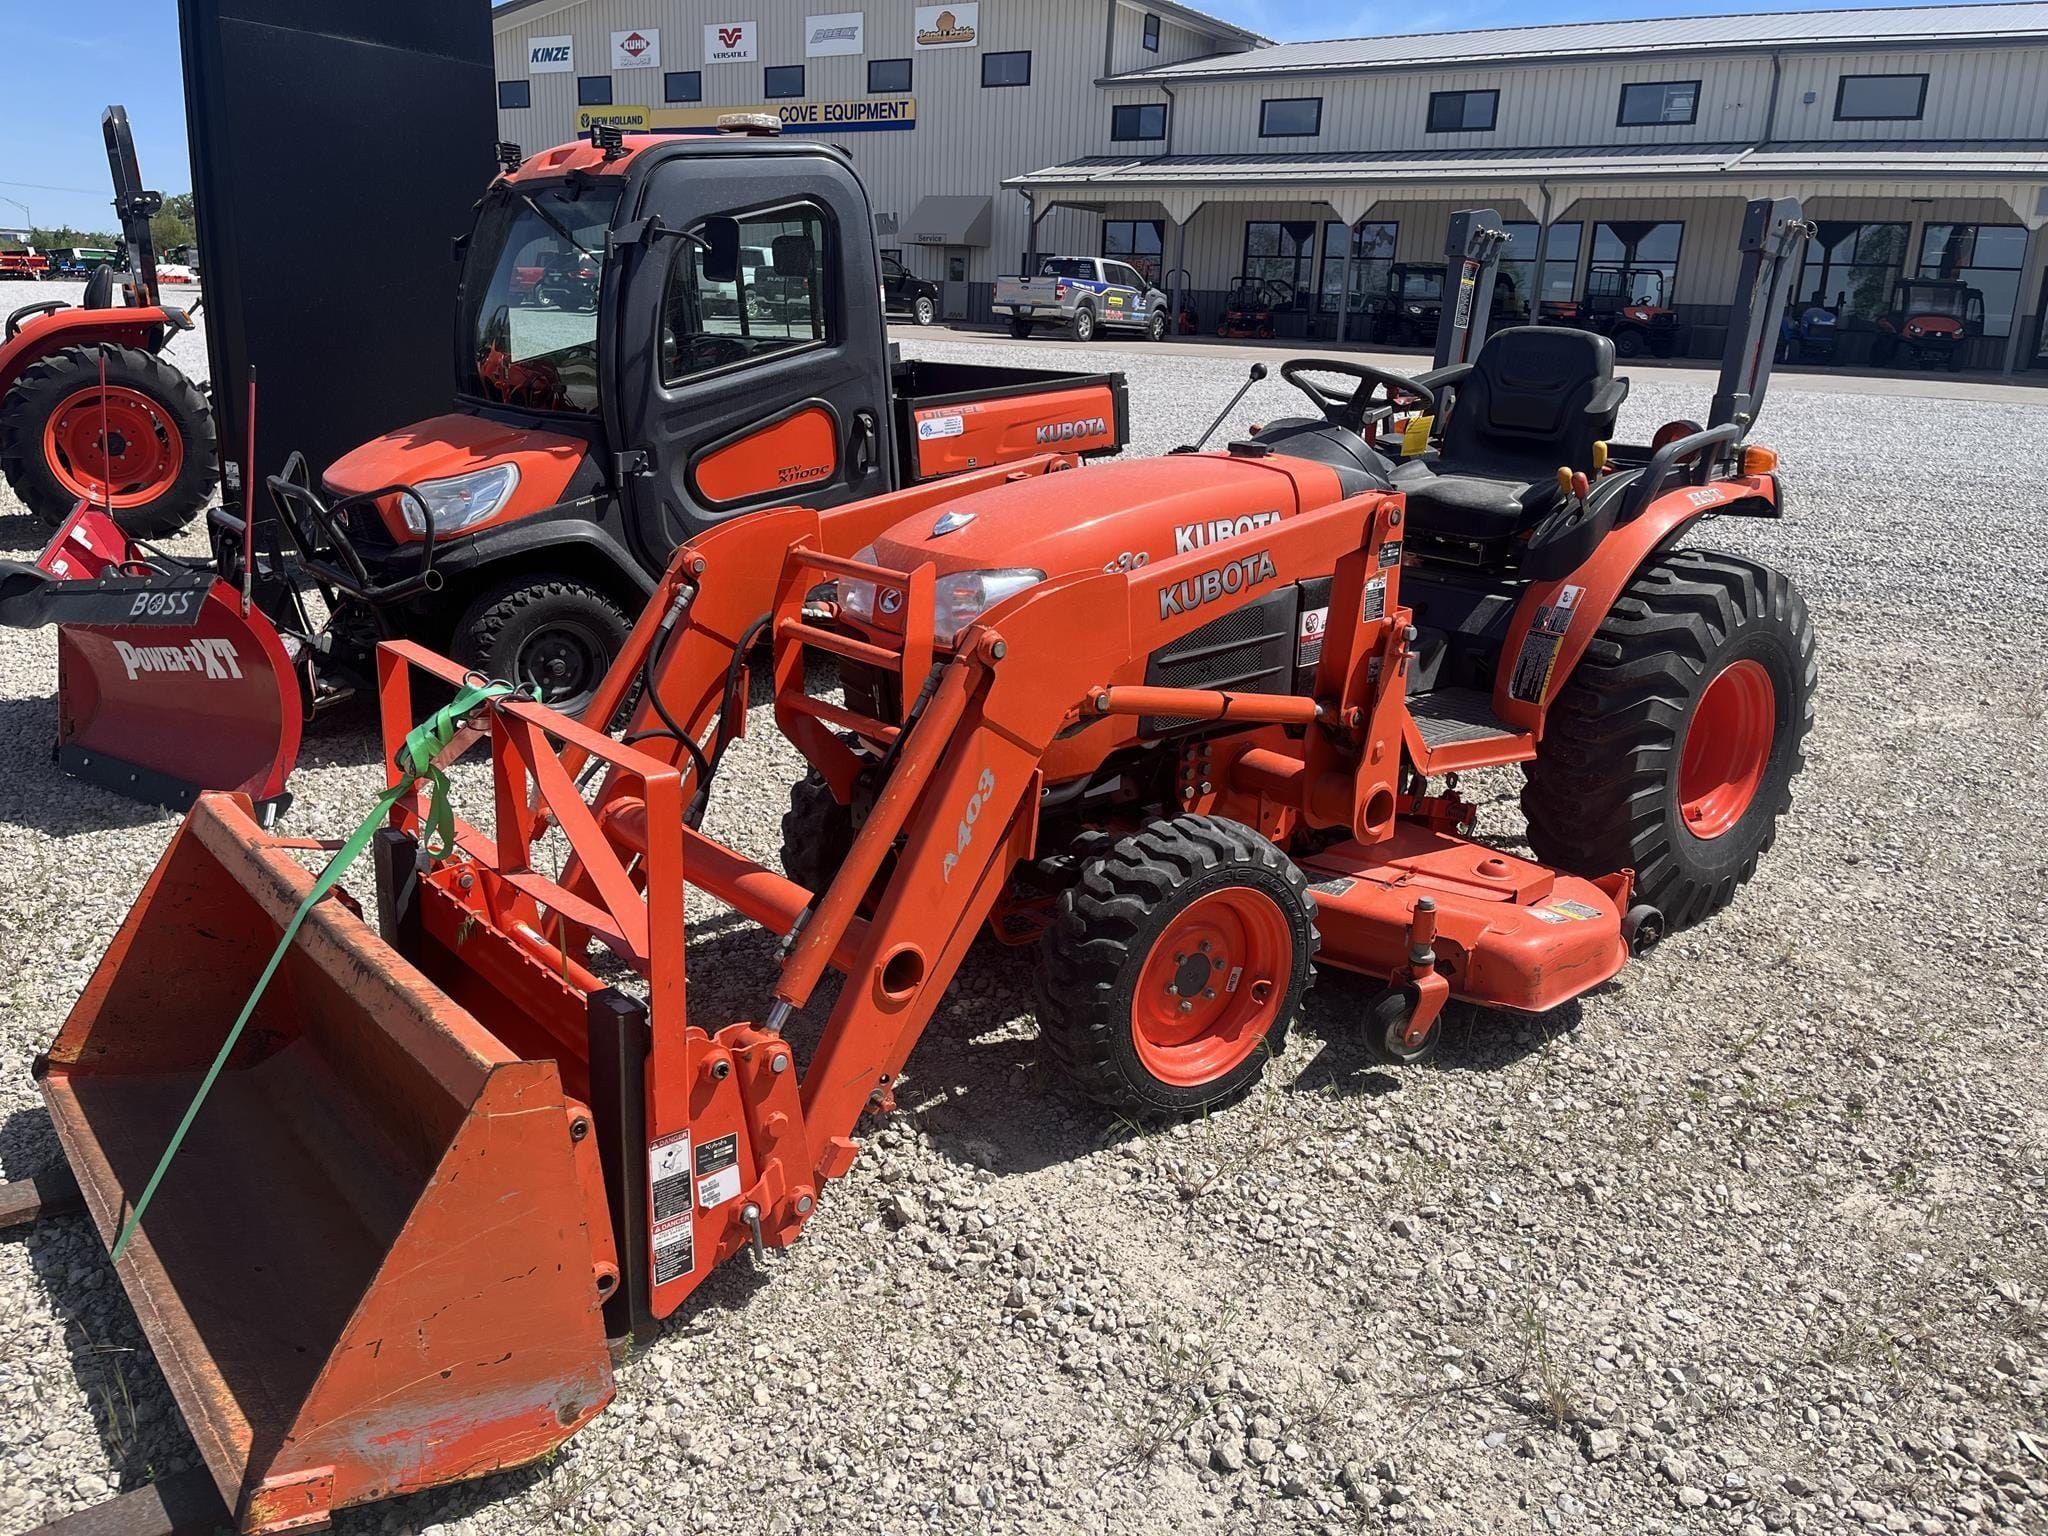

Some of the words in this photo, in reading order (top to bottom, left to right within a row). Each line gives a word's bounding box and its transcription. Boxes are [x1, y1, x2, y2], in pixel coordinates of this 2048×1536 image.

[623, 39, 647, 50] KUHN
[531, 46, 570, 63] KINZE
[713, 51, 748, 59] VERSATILE
[591, 116, 608, 125] NEW
[609, 115, 643, 125] HOLLAND
[779, 104, 819, 123] COVE
[823, 101, 908, 121] EQUIPMENT
[918, 233, 943, 243] Service
[922, 405, 982, 420] DIESEL
[1035, 416, 1108, 444] KUBOTA
[777, 464, 830, 485] X1100C
[778, 464, 802, 476] RTV
[1158, 548, 1278, 620] KUBOTA
[129, 591, 194, 616] BOSS
[943, 767, 995, 885] A403
[659, 1131, 688, 1147] DANGER
[661, 1214, 690, 1231] DANGER
